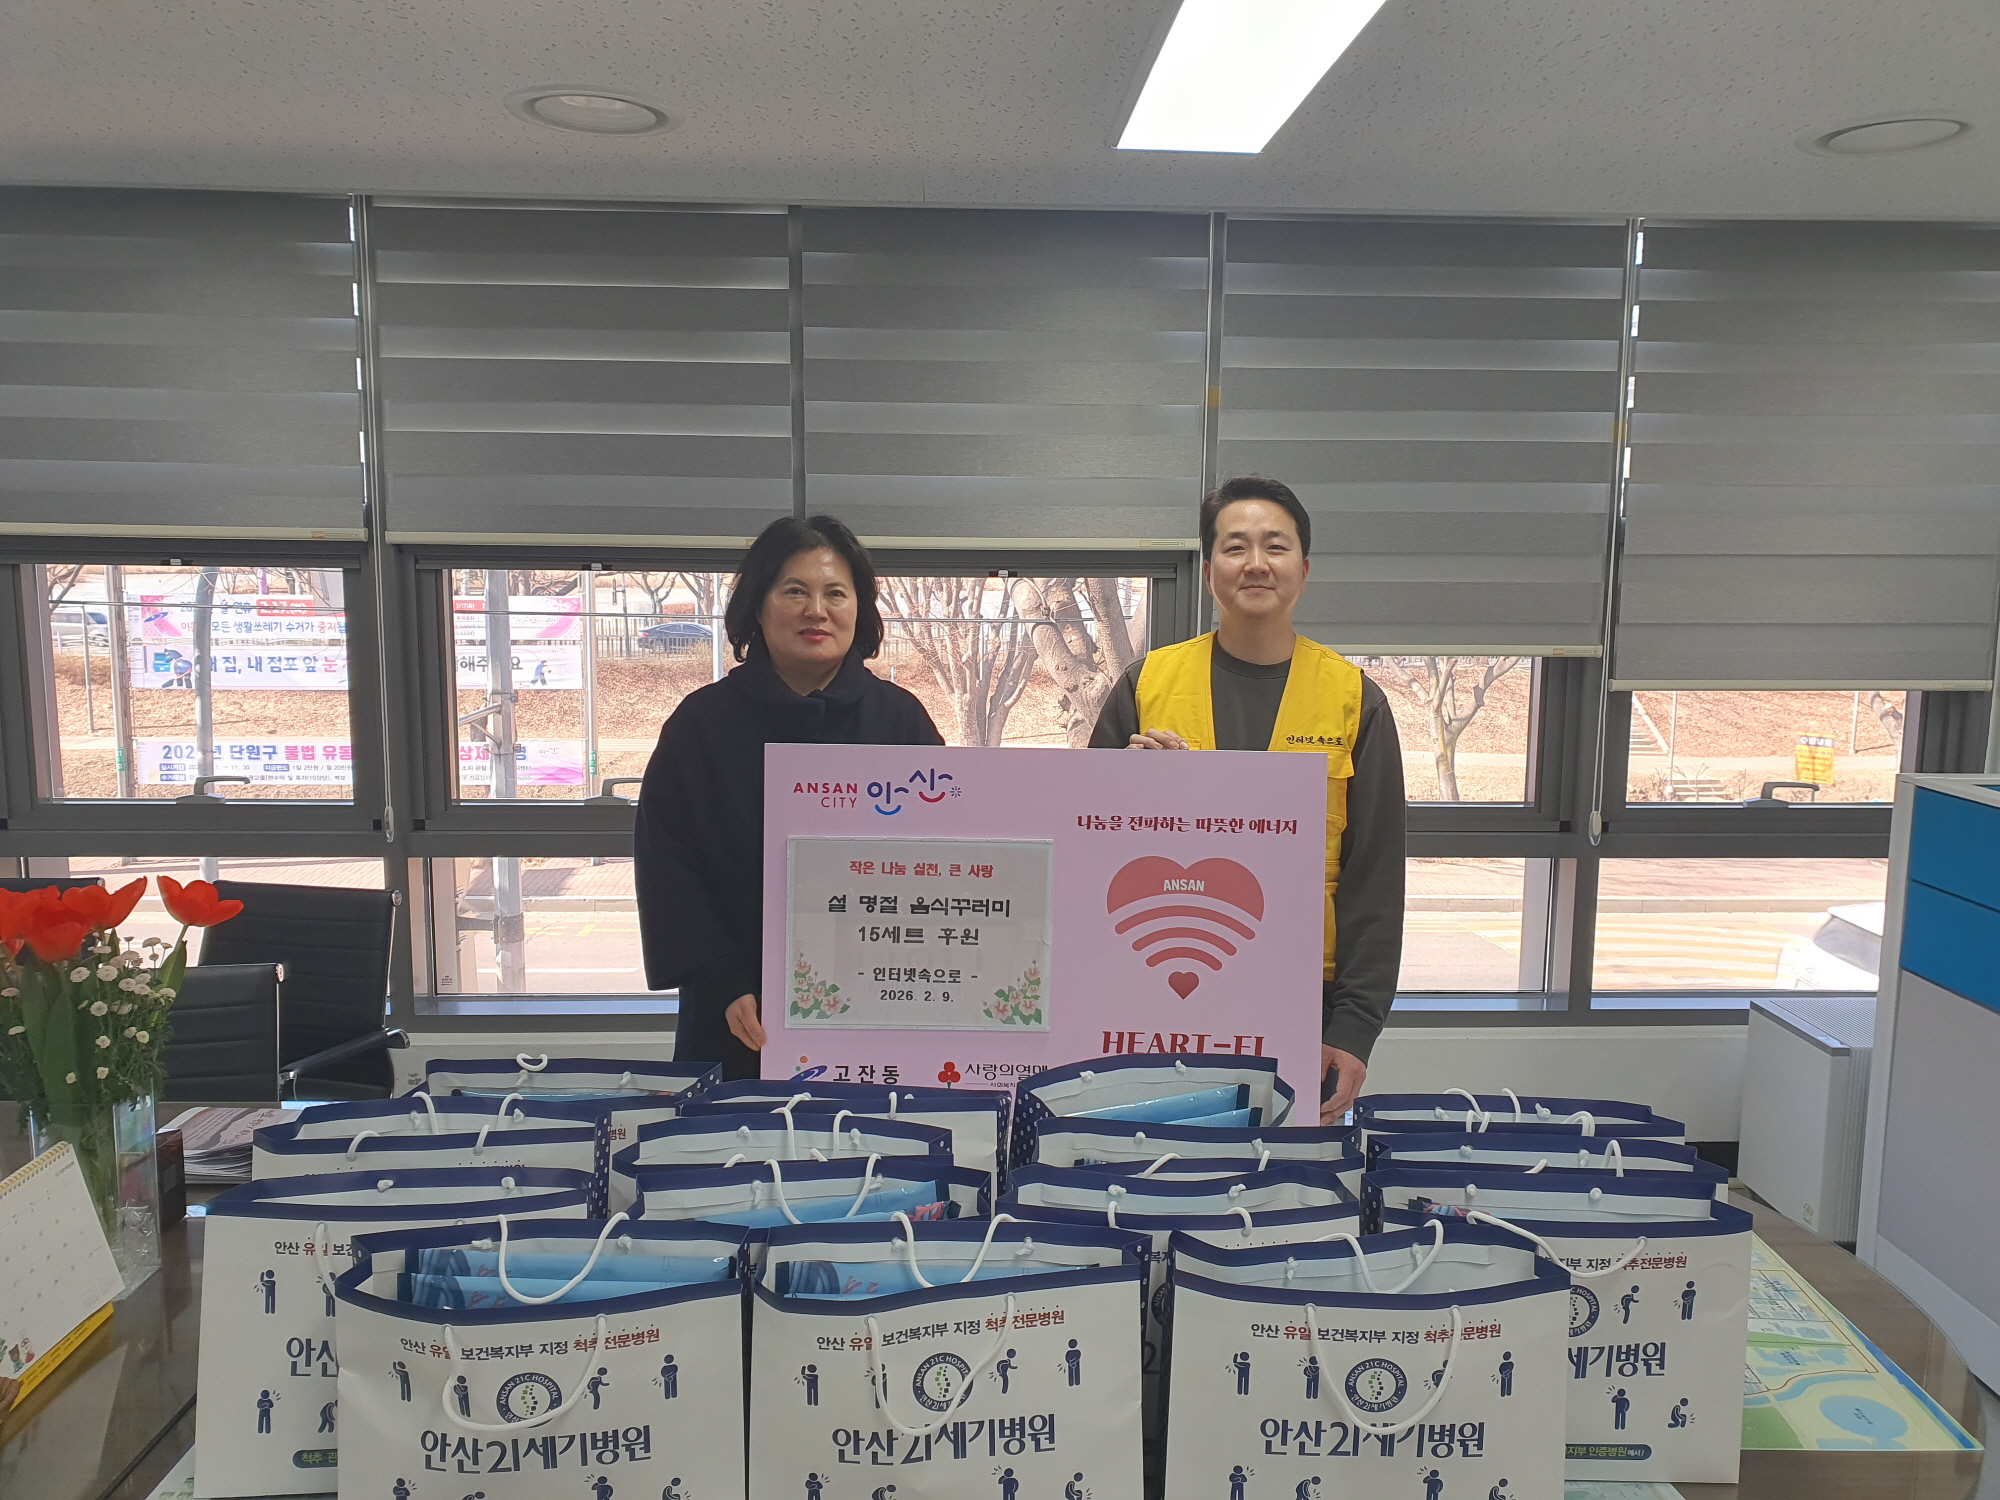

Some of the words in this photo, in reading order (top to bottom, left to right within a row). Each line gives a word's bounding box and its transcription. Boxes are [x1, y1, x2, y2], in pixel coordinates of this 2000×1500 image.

[211, 621, 231, 633] 모든
[233, 621, 282, 634] 생활쓰레기
[285, 621, 315, 633] 수거가
[222, 656, 242, 674] 집,
[247, 656, 263, 672] 내
[267, 656, 299, 673] 점포
[303, 655, 318, 673] 앞
[322, 656, 338, 673] 눈
[230, 744, 278, 760] 단원구
[284, 745, 316, 760] 불법
[793, 782, 858, 794] ANSAN
[821, 797, 857, 808] CITY
[1076, 814, 1124, 832] 나눔을
[1127, 815, 1191, 833] 전파하는
[1195, 816, 1245, 834] 따뜻한
[1248, 818, 1298, 835] 에너지
[849, 860, 875, 875] 작은
[881, 861, 907, 876] 나눔
[948, 864, 962, 877] 큰
[968, 864, 994, 878] 사랑
[1163, 878, 1205, 892] ANSAN
[828, 894, 847, 913] 설
[859, 895, 898, 914] 명절
[909, 896, 1011, 918] 음식꾸러미
[858, 925, 925, 944] 15세트
[937, 927, 980, 946] 후원
[873, 967, 961, 983] 인터넷속으로
[880, 989, 917, 1001] 2026.
[924, 991, 936, 1002] 2.
[942, 992, 954, 1002] 9.
[274, 1241, 300, 1255] 안산
[1585, 1257, 1611, 1271] 지정
[817, 1336, 845, 1351] 안산
[881, 1322, 949, 1347] 보건복지부
[953, 1319, 981, 1336] 지정
[1251, 1323, 1280, 1339] 안산
[1282, 1326, 1312, 1342] 유일
[1317, 1327, 1387, 1344] 보건복지부
[1391, 1330, 1420, 1345] 지정
[400, 1337, 426, 1355] 안산
[460, 1343, 535, 1361] 보건복지부
[539, 1340, 569, 1357] 지정
[916, 1362, 930, 1387] ANSAN
[929, 1355, 945, 1365] 21C
[1348, 1365, 1365, 1387] ANSAN
[1364, 1361, 1380, 1369] 21C
[1381, 1361, 1405, 1388] HOSPITAL
[499, 1381, 515, 1405] ANSAN
[514, 1374, 531, 1384] 21C
[531, 1374, 559, 1400] HOSPITAL
[1260, 1418, 1485, 1459] 안산21세기병원
[420, 1425, 652, 1475] 안산21세기병원
